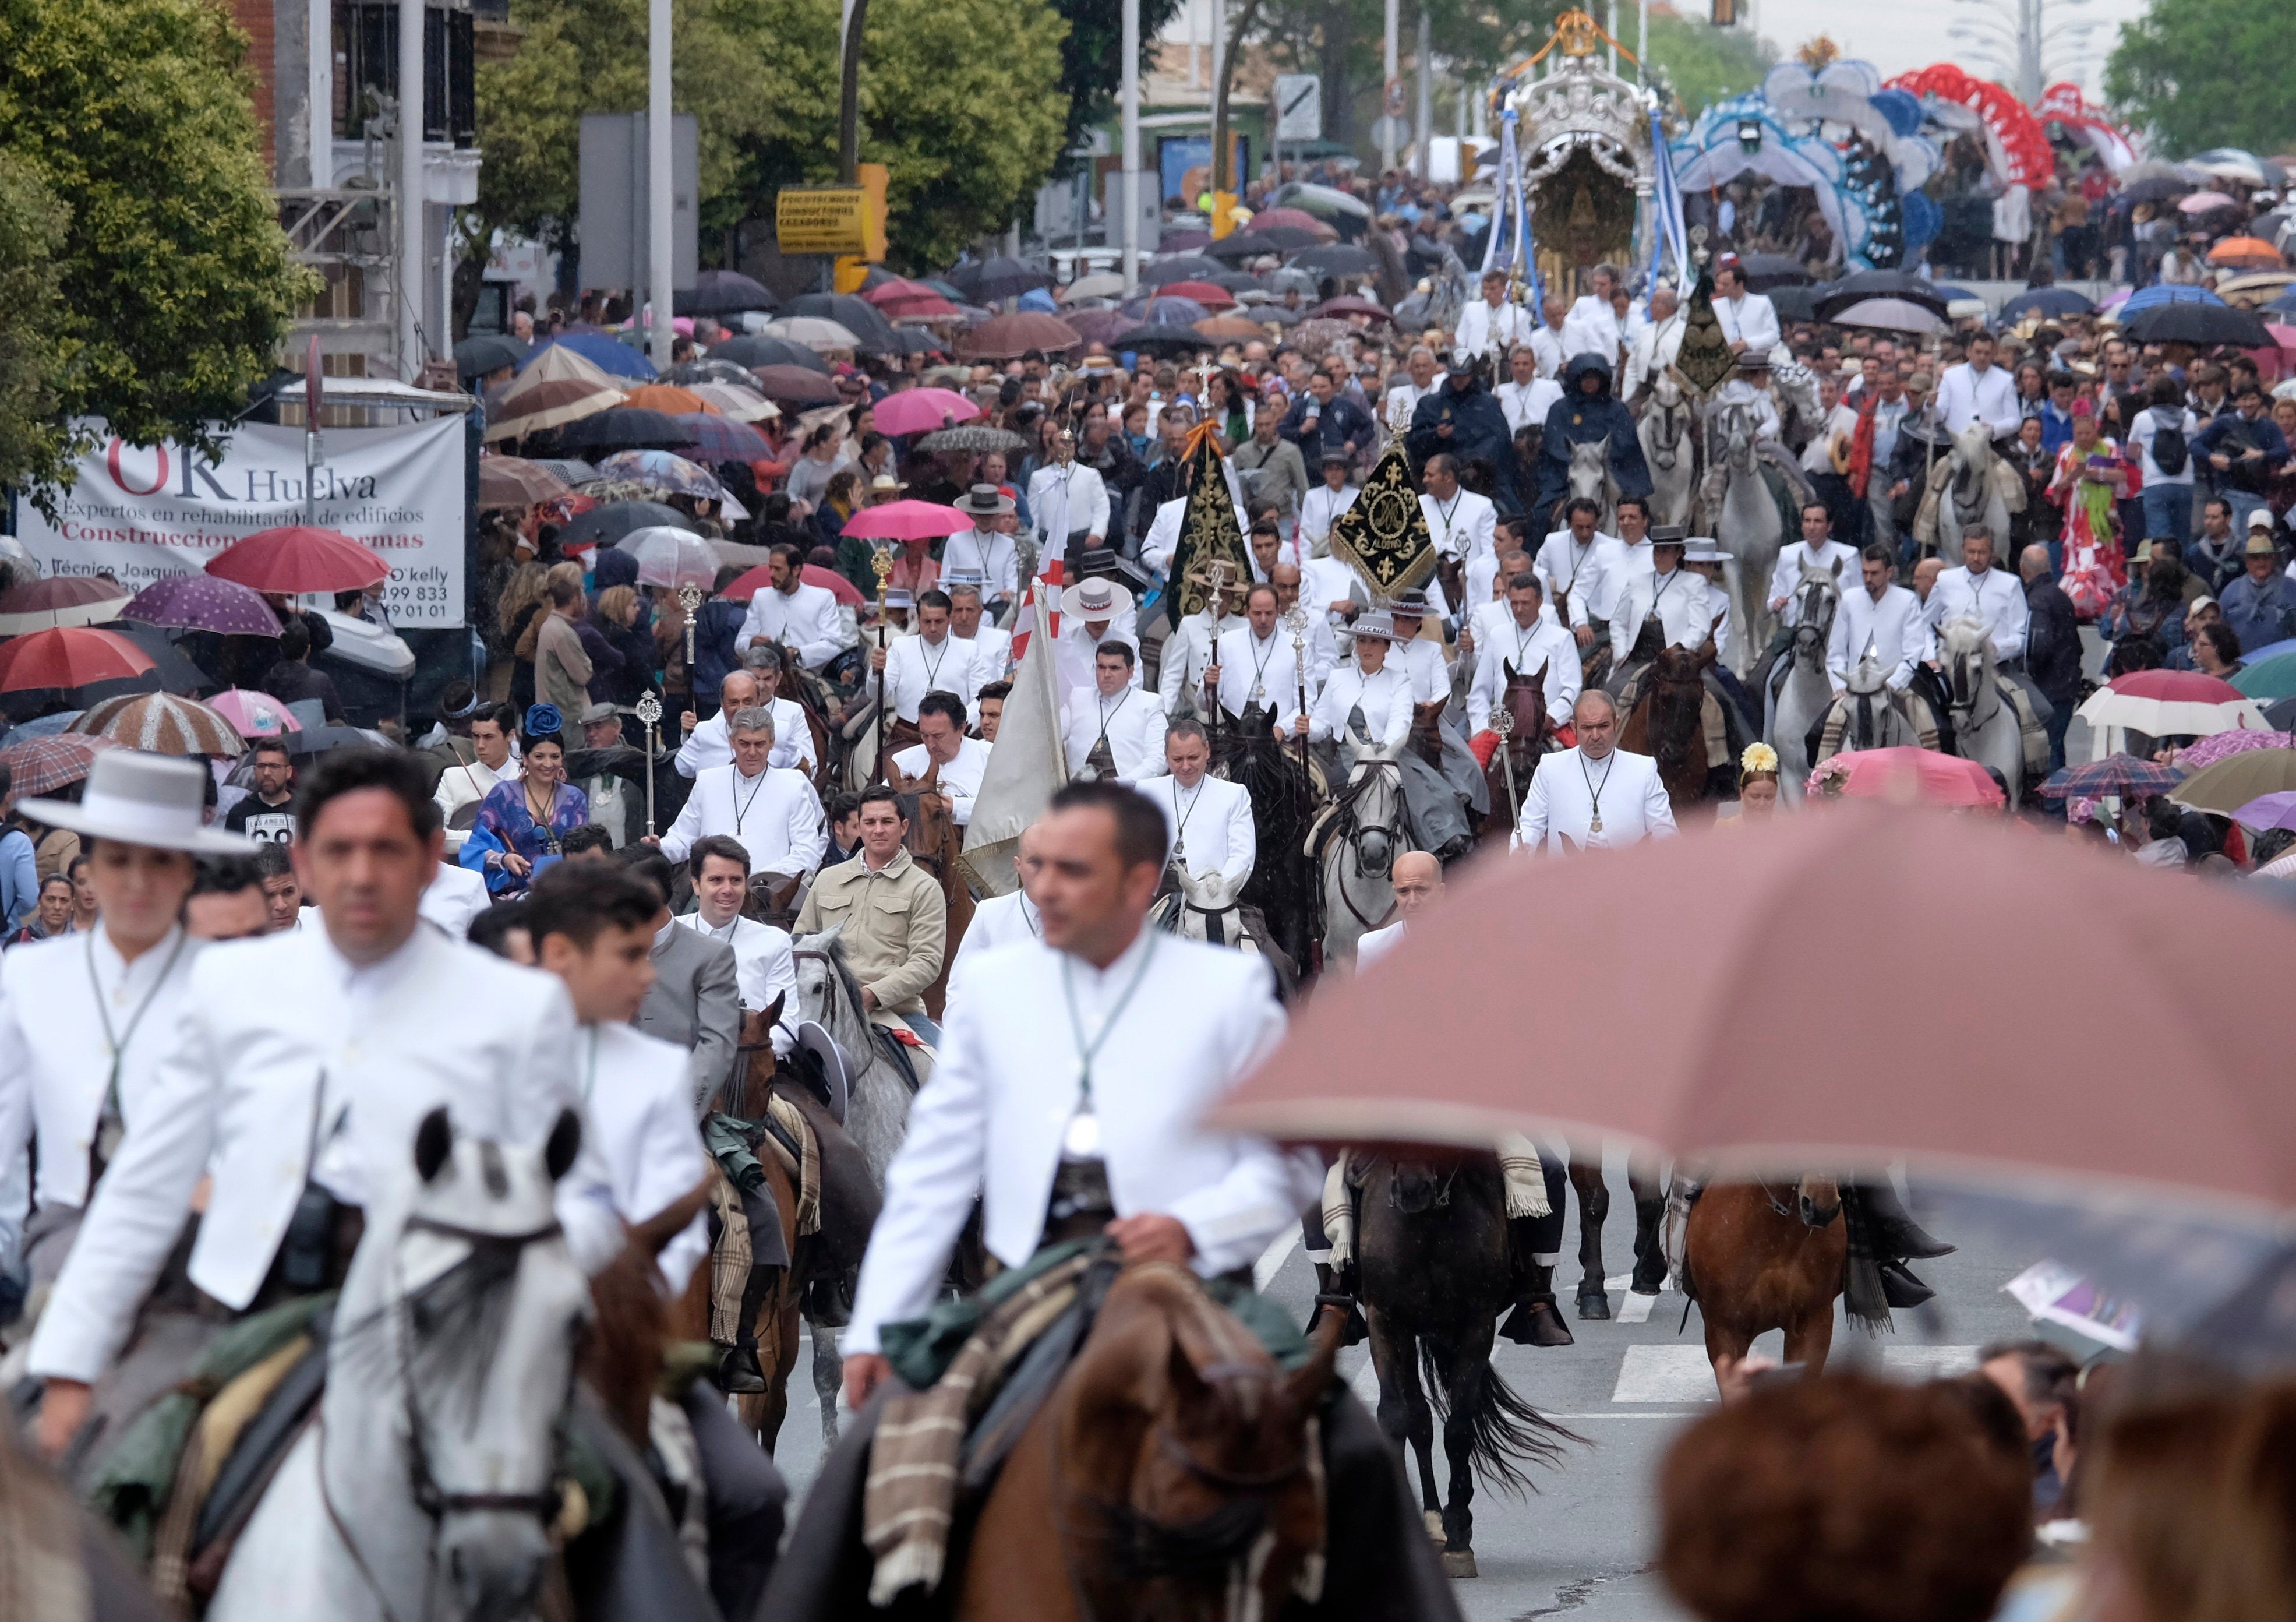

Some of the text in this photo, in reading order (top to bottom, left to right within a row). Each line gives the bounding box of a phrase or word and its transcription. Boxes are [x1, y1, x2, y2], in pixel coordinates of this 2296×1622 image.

[244, 467, 378, 502] Huelva
[63, 499, 146, 521] Expertos
[152, 507, 174, 522] en
[318, 507, 340, 525] de
[345, 506, 425, 524] edificios
[416, 587, 447, 601] 833
[405, 605, 422, 618] 01
[429, 605, 446, 617] 01
[1358, 626, 1387, 634] OSNO
